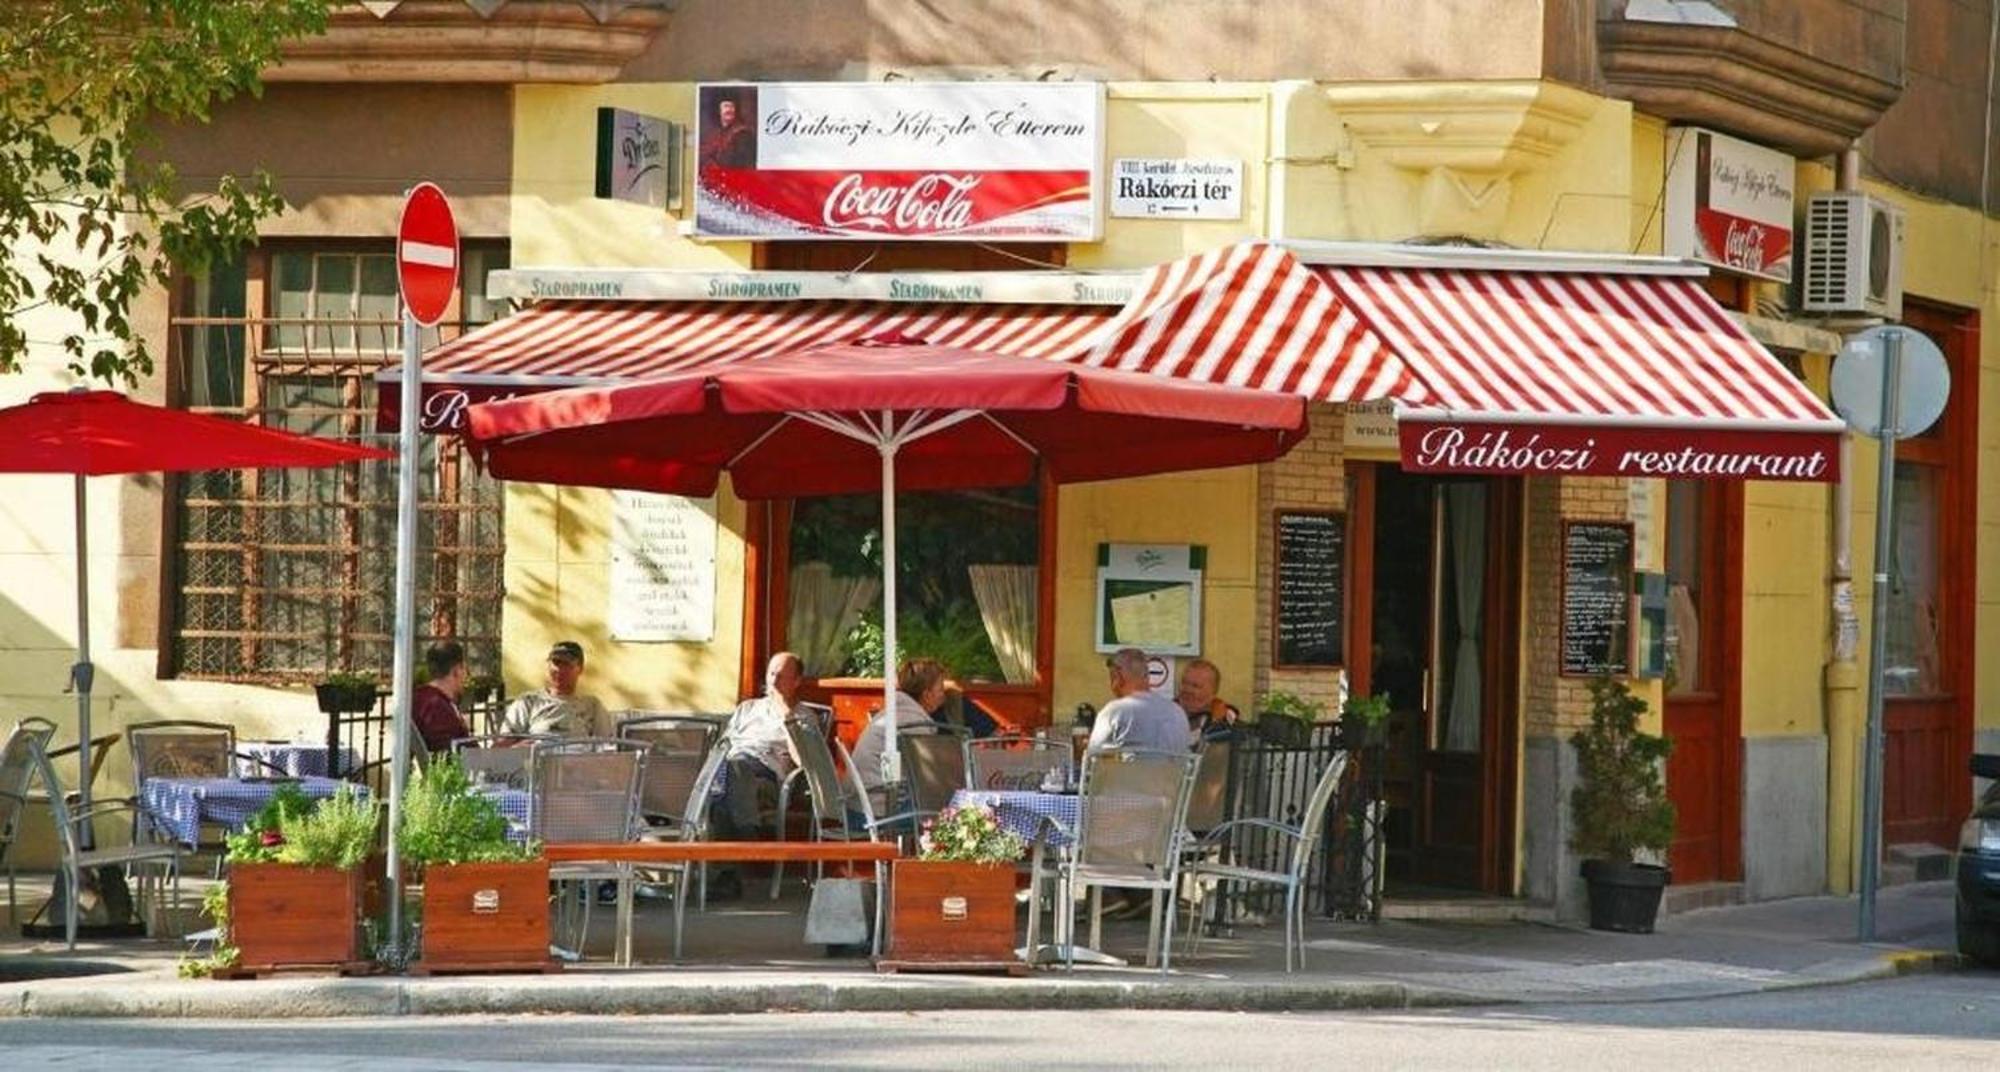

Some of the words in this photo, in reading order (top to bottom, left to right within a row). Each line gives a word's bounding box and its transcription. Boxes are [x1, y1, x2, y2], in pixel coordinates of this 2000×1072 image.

[1119, 177, 1197, 199] Rákóczi
[1203, 179, 1232, 200] tér
[1417, 426, 1596, 471] Rákóczi
[1618, 446, 1828, 478] restaurant
